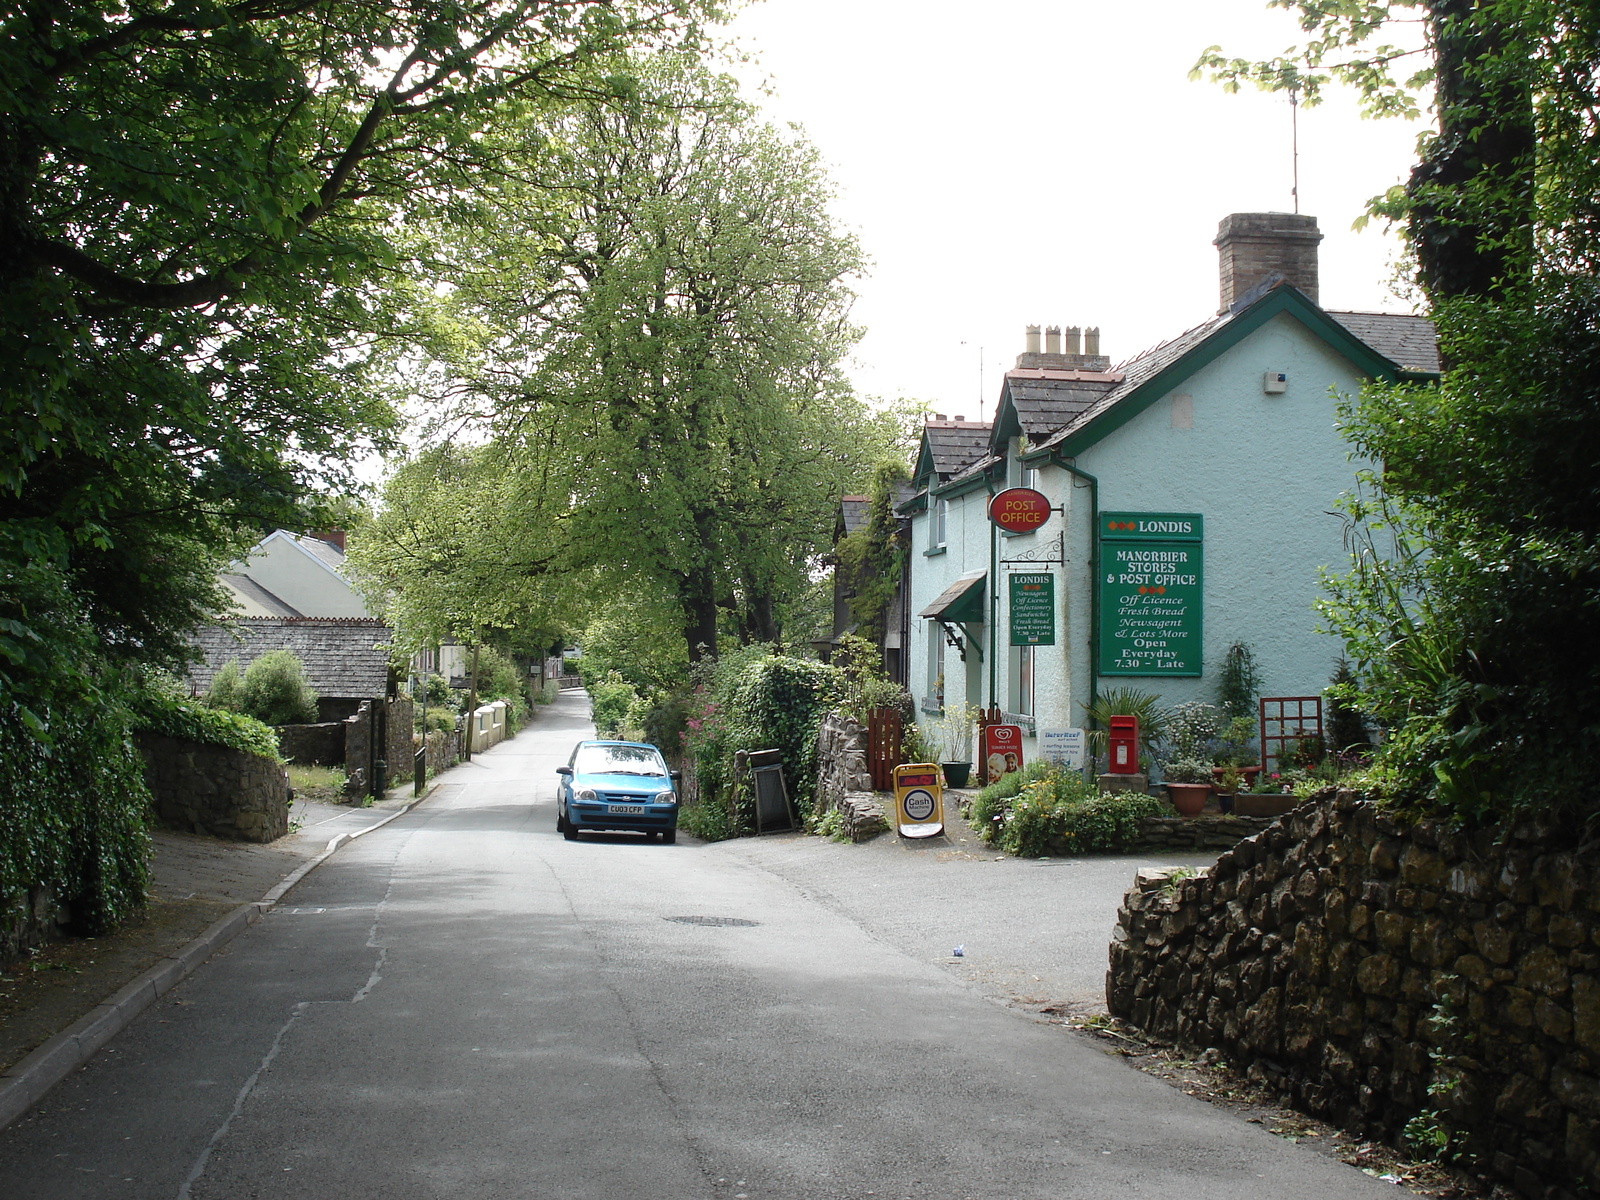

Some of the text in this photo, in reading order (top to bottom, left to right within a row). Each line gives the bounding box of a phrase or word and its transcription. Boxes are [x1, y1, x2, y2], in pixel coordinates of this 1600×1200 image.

[1006, 500, 1036, 510] POST
[1000, 512, 1040, 522] OFFICE
[1139, 521, 1192, 533] LONDIS
[1116, 551, 1188, 562] MANORBIER
[1128, 562, 1176, 573] STORES
[1014, 576, 1050, 584] LONDIS
[1106, 574, 1196, 586] & POST OFFICE
[1120, 595, 1183, 606] Off Licence
[1118, 606, 1187, 616] Fresh Bread
[1119, 618, 1182, 629] Newsagent
[1114, 629, 1128, 638] &
[1130, 630, 1156, 638] Lots
[1134, 638, 1166, 648] Open
[1122, 649, 1178, 659] Everyday
[1114, 660, 1140, 668] 7.30
[1157, 660, 1184, 668] Late
